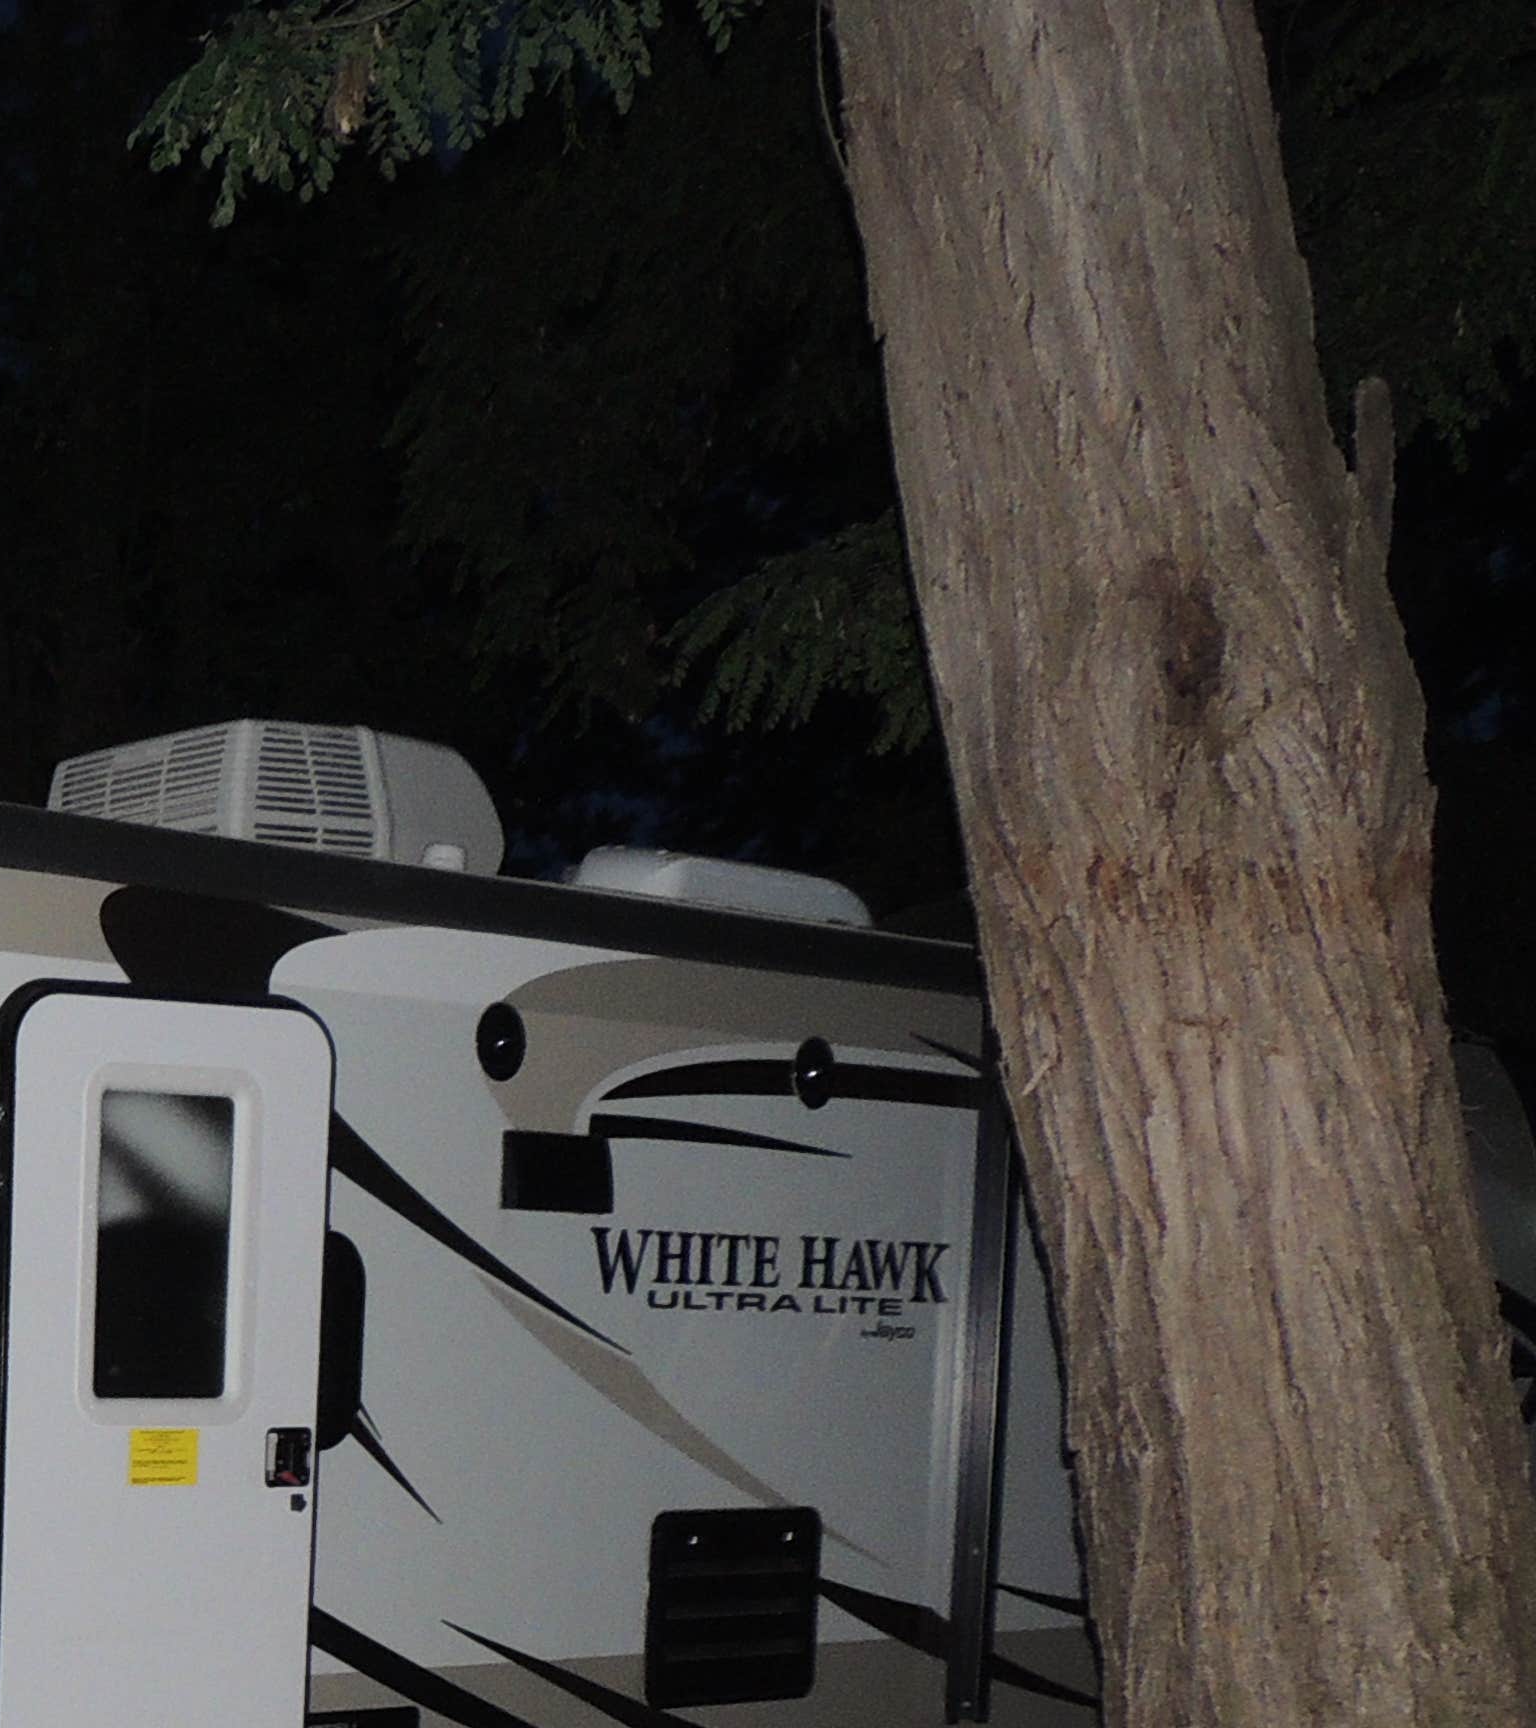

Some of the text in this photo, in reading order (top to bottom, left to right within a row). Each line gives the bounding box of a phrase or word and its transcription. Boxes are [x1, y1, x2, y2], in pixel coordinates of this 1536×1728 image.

[590, 1226, 950, 1303] WHITE HAWK
[647, 1289, 904, 1316] ULTRA LITE
